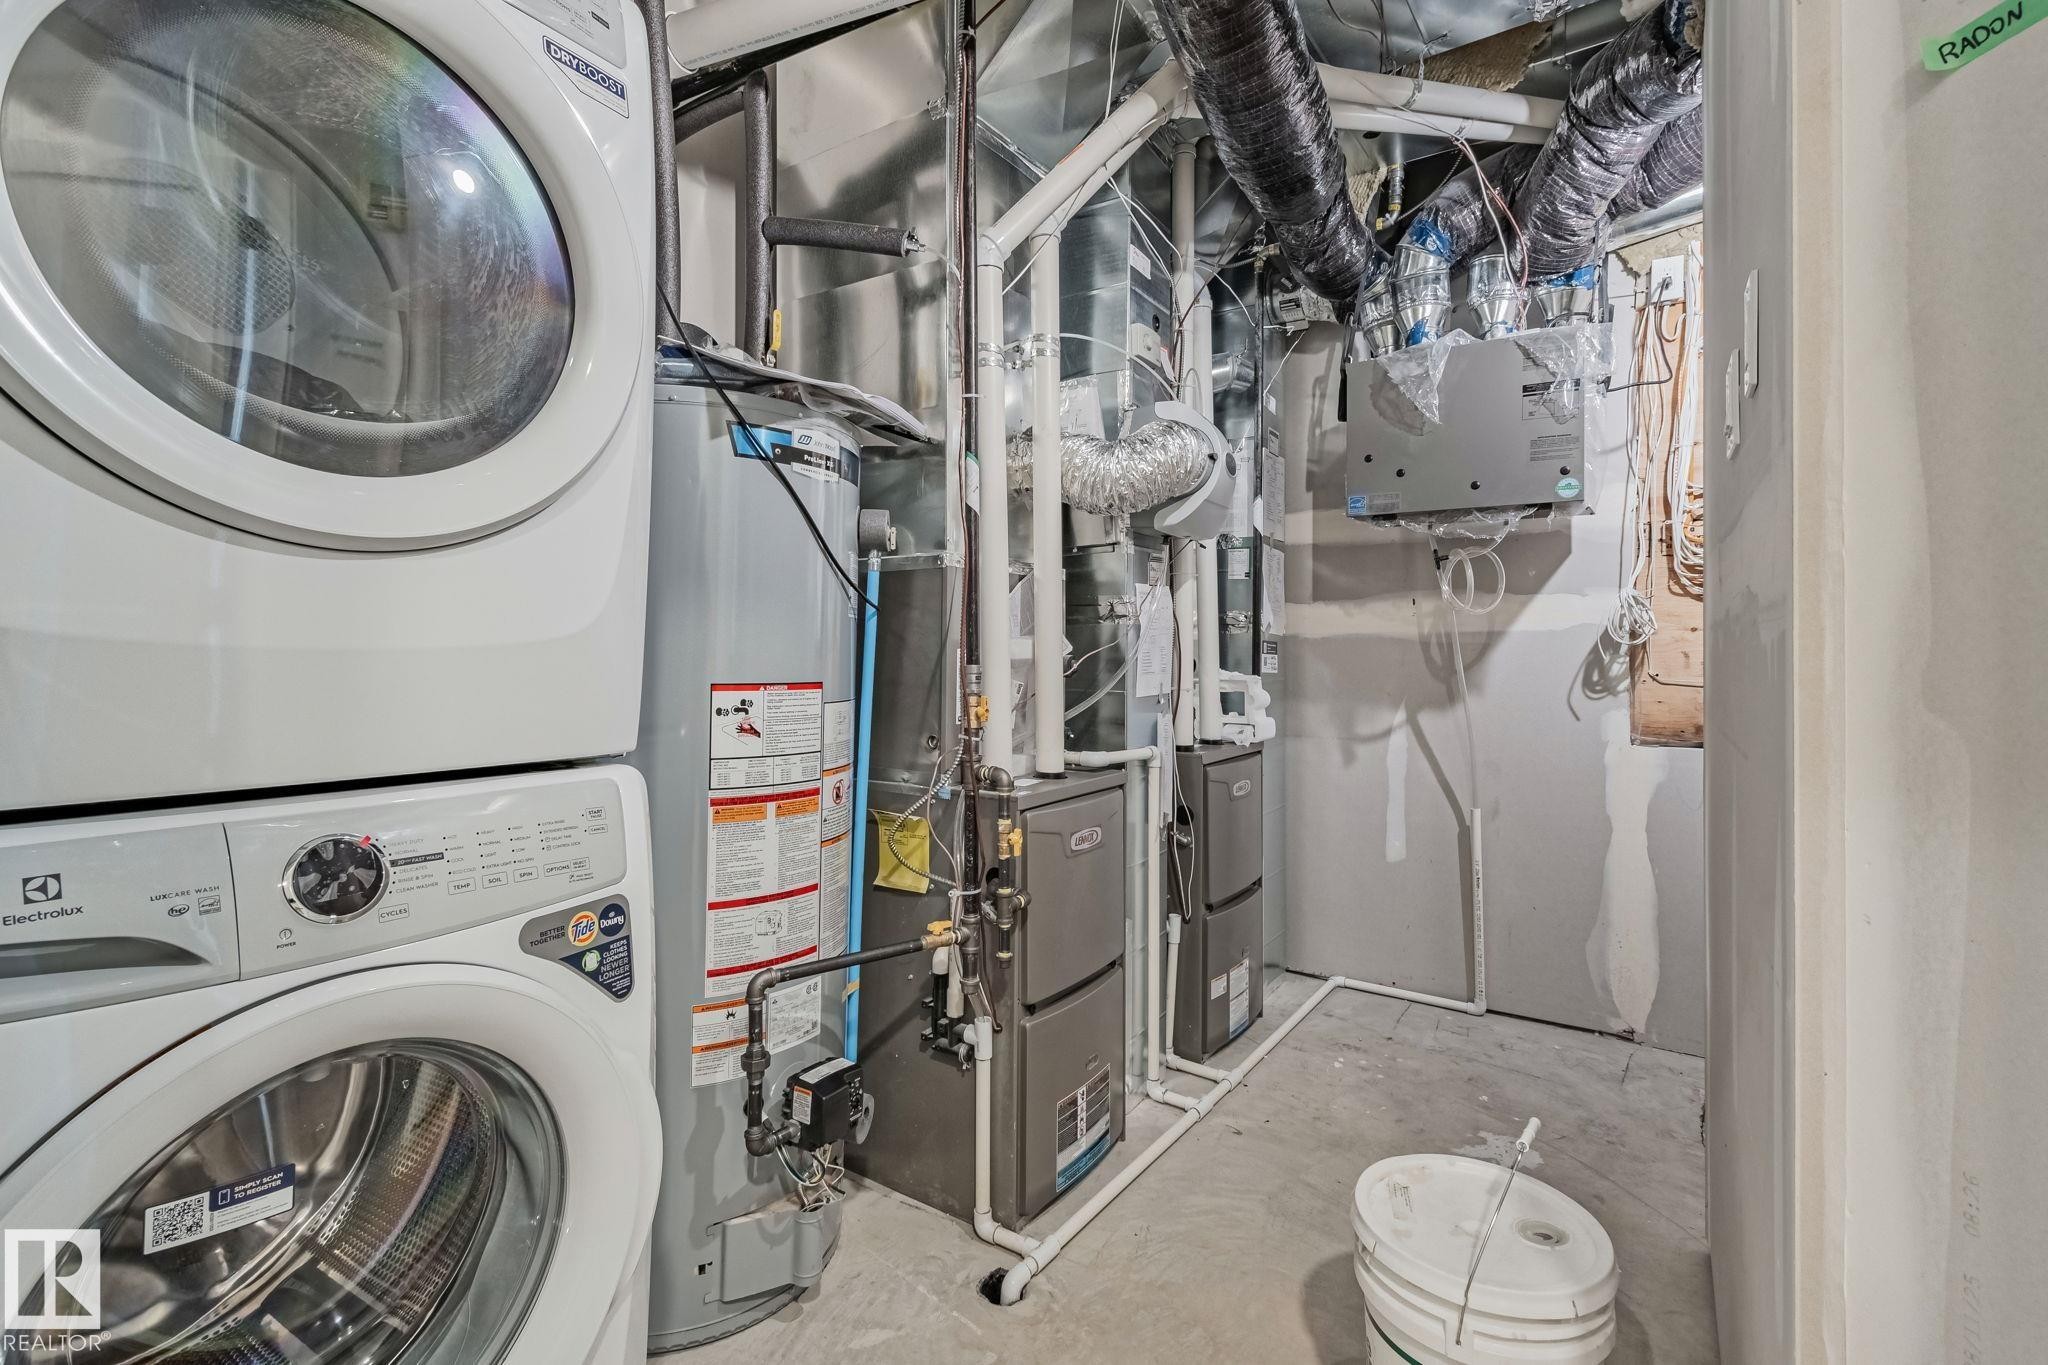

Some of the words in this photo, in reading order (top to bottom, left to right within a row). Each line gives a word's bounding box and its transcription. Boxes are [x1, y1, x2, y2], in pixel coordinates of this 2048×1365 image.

[1938, 1, 2023, 64] RADON
[550, 43, 623, 96] DRYBOOST
[426, 853, 443, 861] WASH
[546, 865, 570, 873] OPTIONS
[150, 889, 191, 902] LUXCARE
[195, 885, 220, 894] WASH
[396, 886, 415, 894] CLEAN
[416, 881, 439, 889] WASHER
[453, 883, 471, 891] TEMP
[2, 905, 84, 927] Electrolux
[380, 907, 408, 918] CYCLES
[600, 915, 624, 928] Downy
[539, 925, 565, 938] BETTER
[571, 919, 596, 943] Tide
[276, 941, 297, 949] POWER
[530, 931, 566, 947] TOGETHER
[610, 939, 628, 949] KEEPS
[603, 945, 628, 958] CLOTHES
[603, 951, 628, 964] LOOKING
[600, 957, 629, 973] NEWER
[599, 964, 630, 982] LONGER
[234, 1179, 262, 1193] SIMPLY
[262, 1171, 283, 1184] SCAN
[234, 1191, 246, 1200] TO
[246, 1179, 281, 1196] REGISTER
